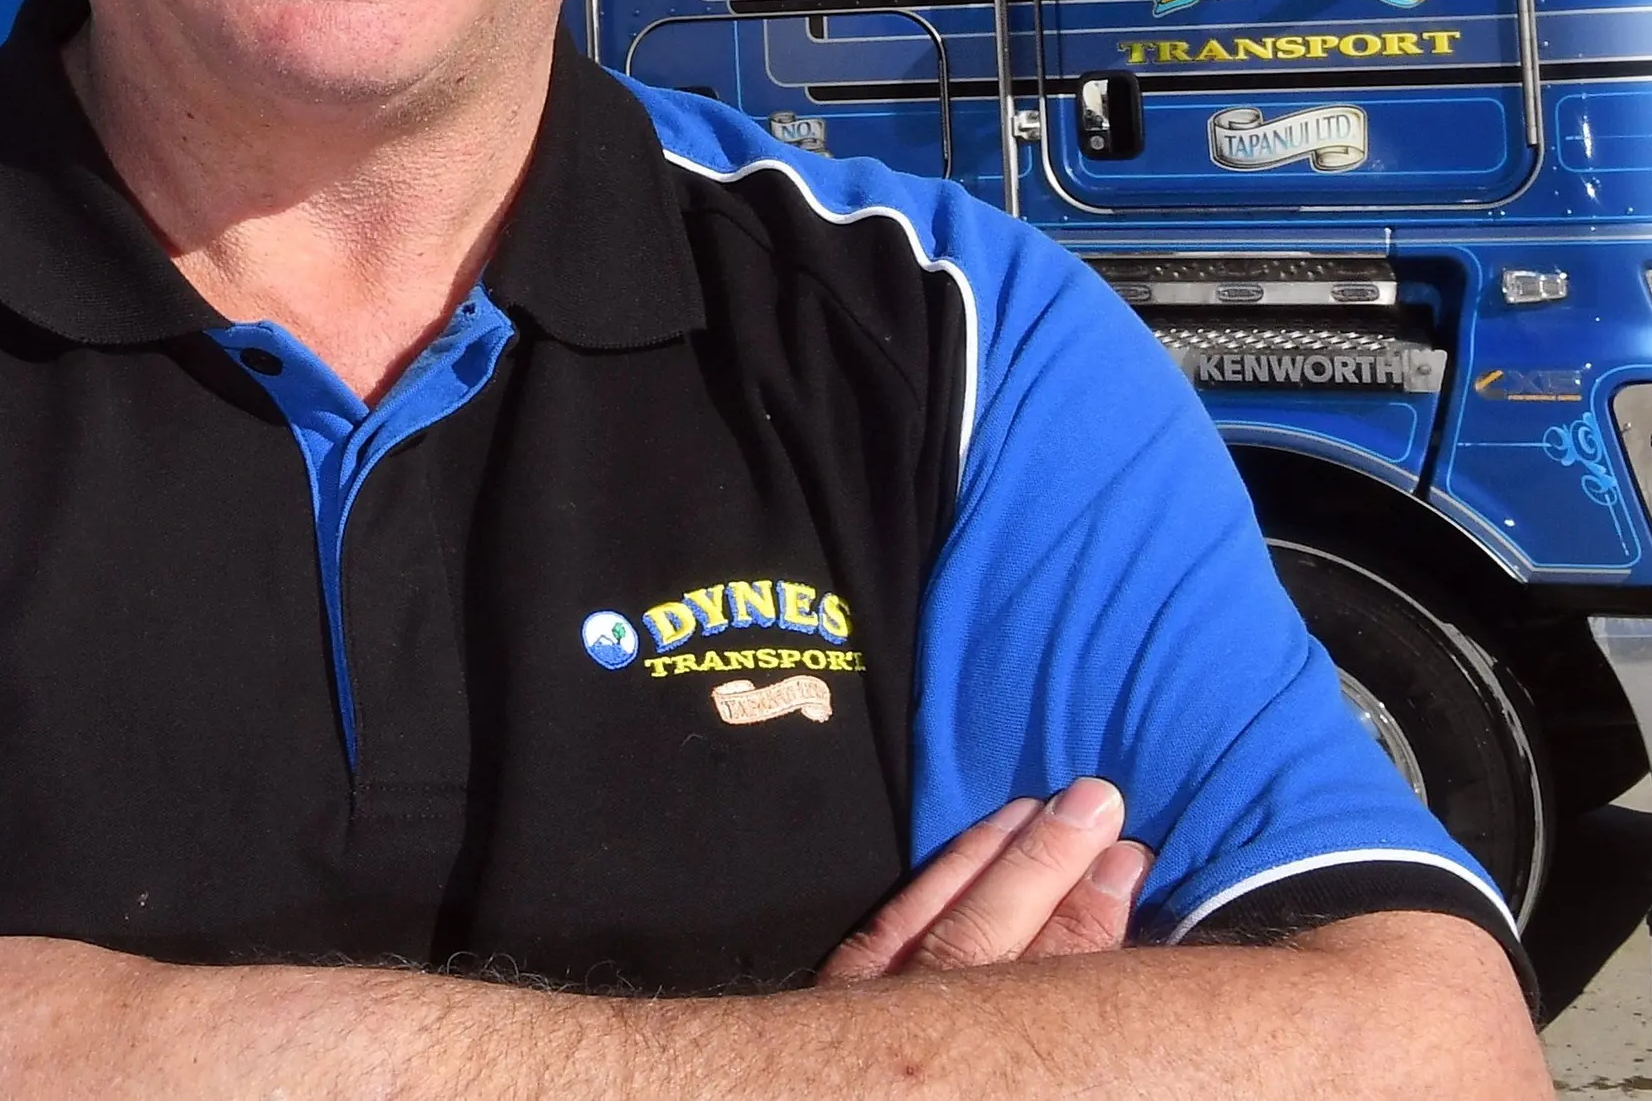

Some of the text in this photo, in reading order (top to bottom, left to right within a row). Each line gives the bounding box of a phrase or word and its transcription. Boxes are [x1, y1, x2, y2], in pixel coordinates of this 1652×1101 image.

[1117, 31, 1460, 64] TRANSPORT
[1224, 121, 1310, 158] TAPANUI
[1199, 353, 1402, 384] KENWORTH
[642, 579, 852, 653] DYNES
[644, 649, 866, 678] TRANSPORT
